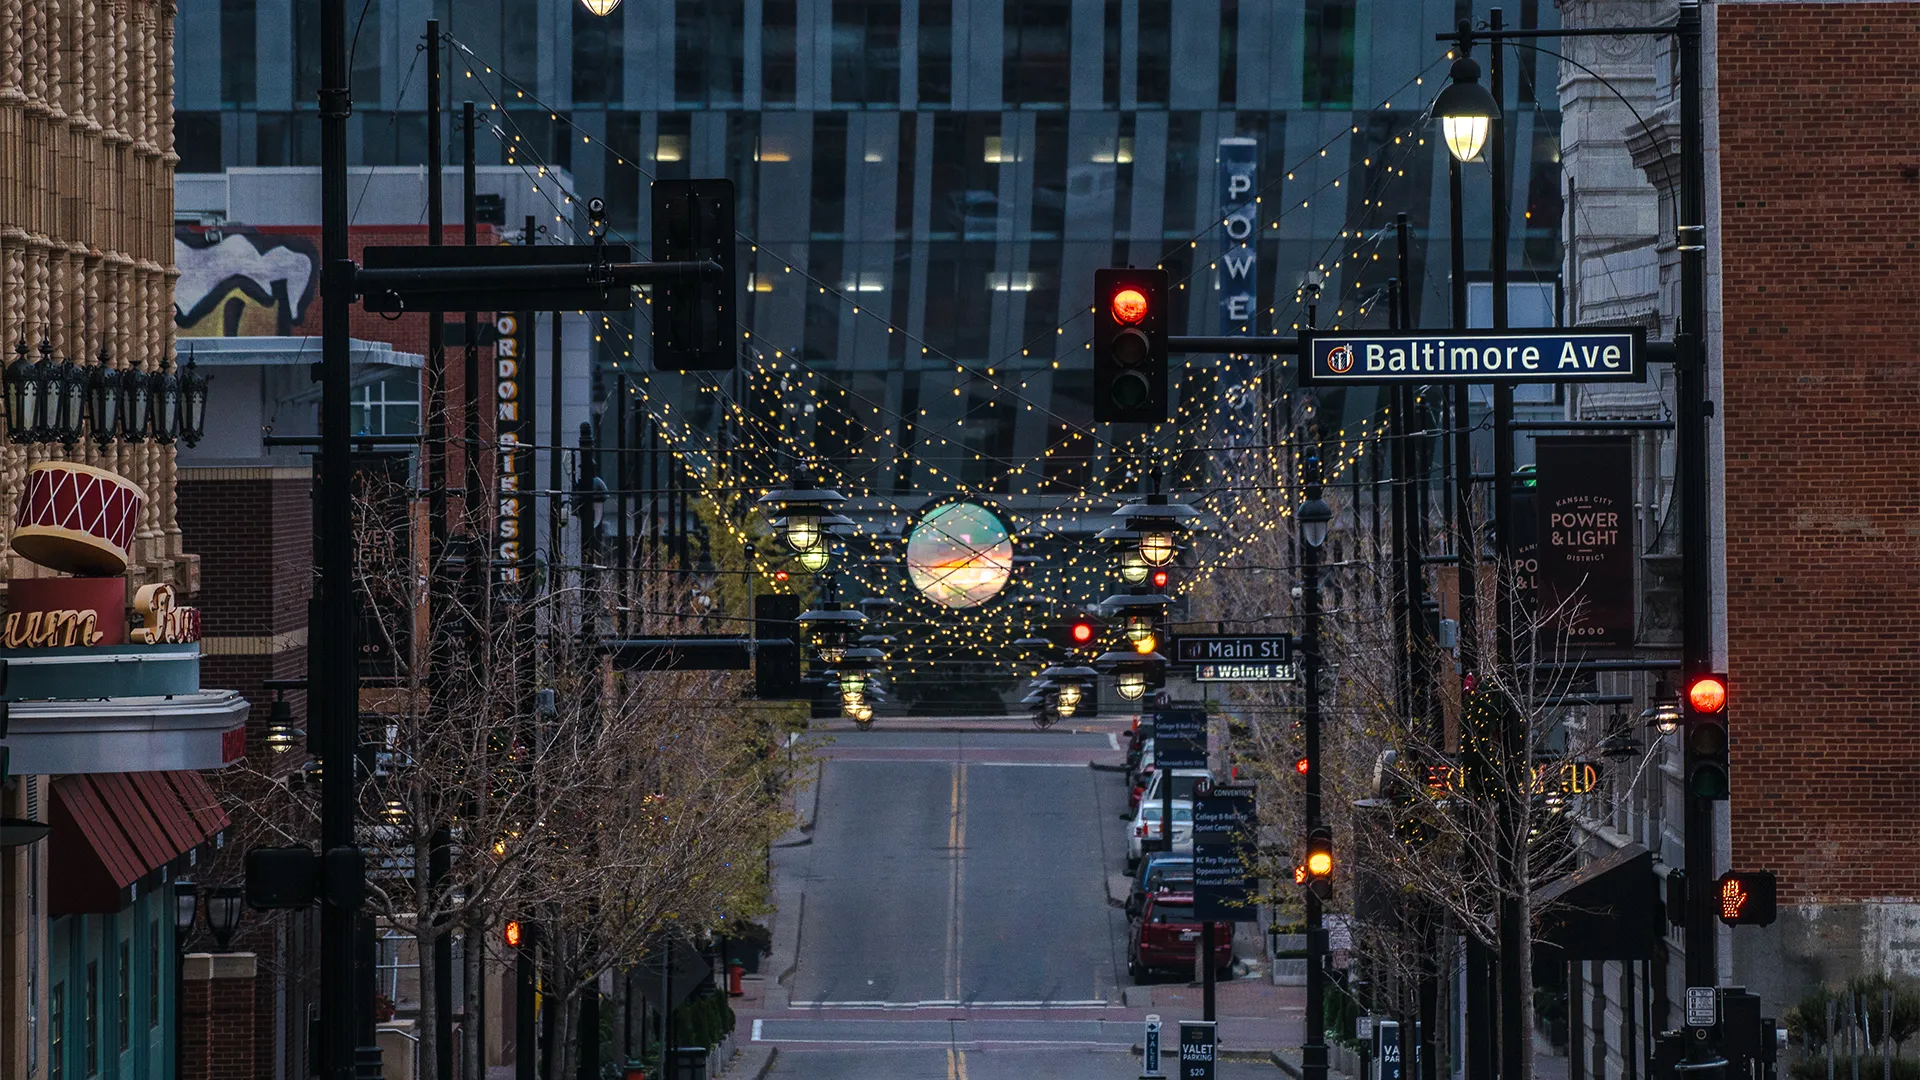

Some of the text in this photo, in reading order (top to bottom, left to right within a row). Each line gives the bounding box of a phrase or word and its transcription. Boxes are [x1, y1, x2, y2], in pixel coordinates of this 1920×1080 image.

[1224, 175, 1252, 322] POWE
[1366, 341, 1621, 372] Baltimore Ave
[498, 314, 518, 421] ORDON
[1555, 495, 1614, 508] KANSAS CITY
[1551, 512, 1619, 528] POWER
[1552, 530, 1619, 546] & LIGHT
[1566, 553, 1605, 562] DISTRICT
[1209, 640, 1279, 658] Main St
[1218, 664, 1290, 678] Walnut St
[1214, 788, 1252, 797] CONVENTION
[1195, 813, 1217, 822] College
[1195, 825, 1213, 833] Sprint
[1207, 857, 1217, 865] Rep
[1195, 867, 1244, 876] Oppenstein Park
[1182, 1044, 1213, 1054] VALET
[1384, 1045, 1421, 1055] VAT
[1183, 1054, 1213, 1062] PARKING
[1189, 1068, 1205, 1077] $20
